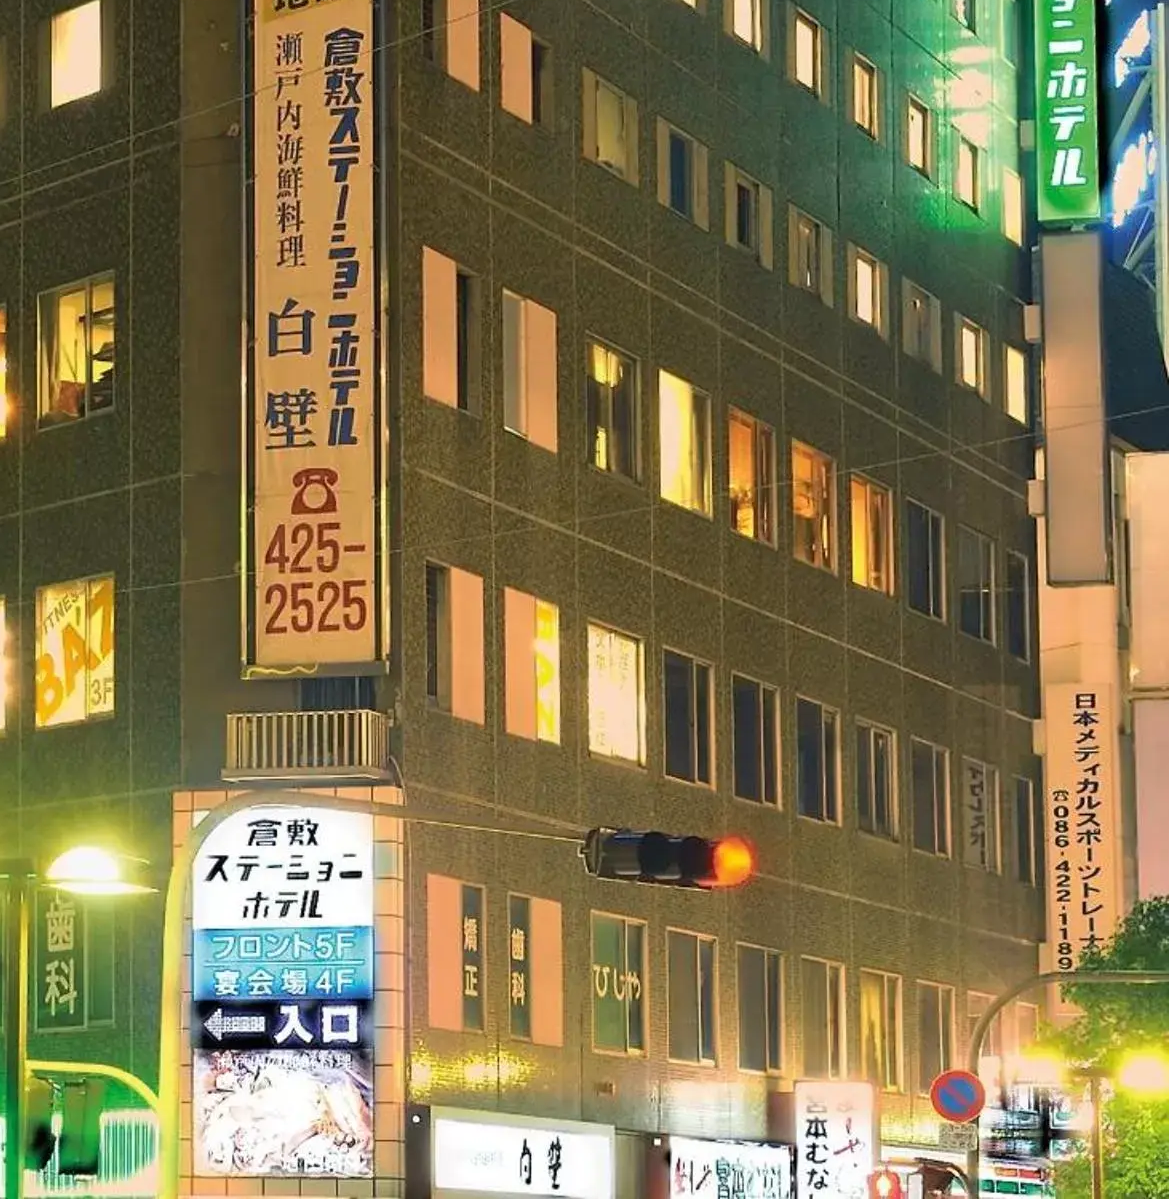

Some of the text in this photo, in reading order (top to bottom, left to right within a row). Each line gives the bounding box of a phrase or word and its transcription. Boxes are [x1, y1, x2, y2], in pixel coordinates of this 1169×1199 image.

[276, 31, 306, 268] 瀬戸内海鮮料理
[265, 298, 317, 450] 白壁
[265, 522, 366, 573] 425-
[265, 579, 367, 634] 2525
[247, 818, 319, 847] 倉敷
[204, 853, 363, 883] ステーション
[242, 890, 323, 920] ホテル
[44, 902, 78, 1017] 歯科
[212, 932, 356, 961] フロント5F
[274, 1004, 361, 1045] 入口
